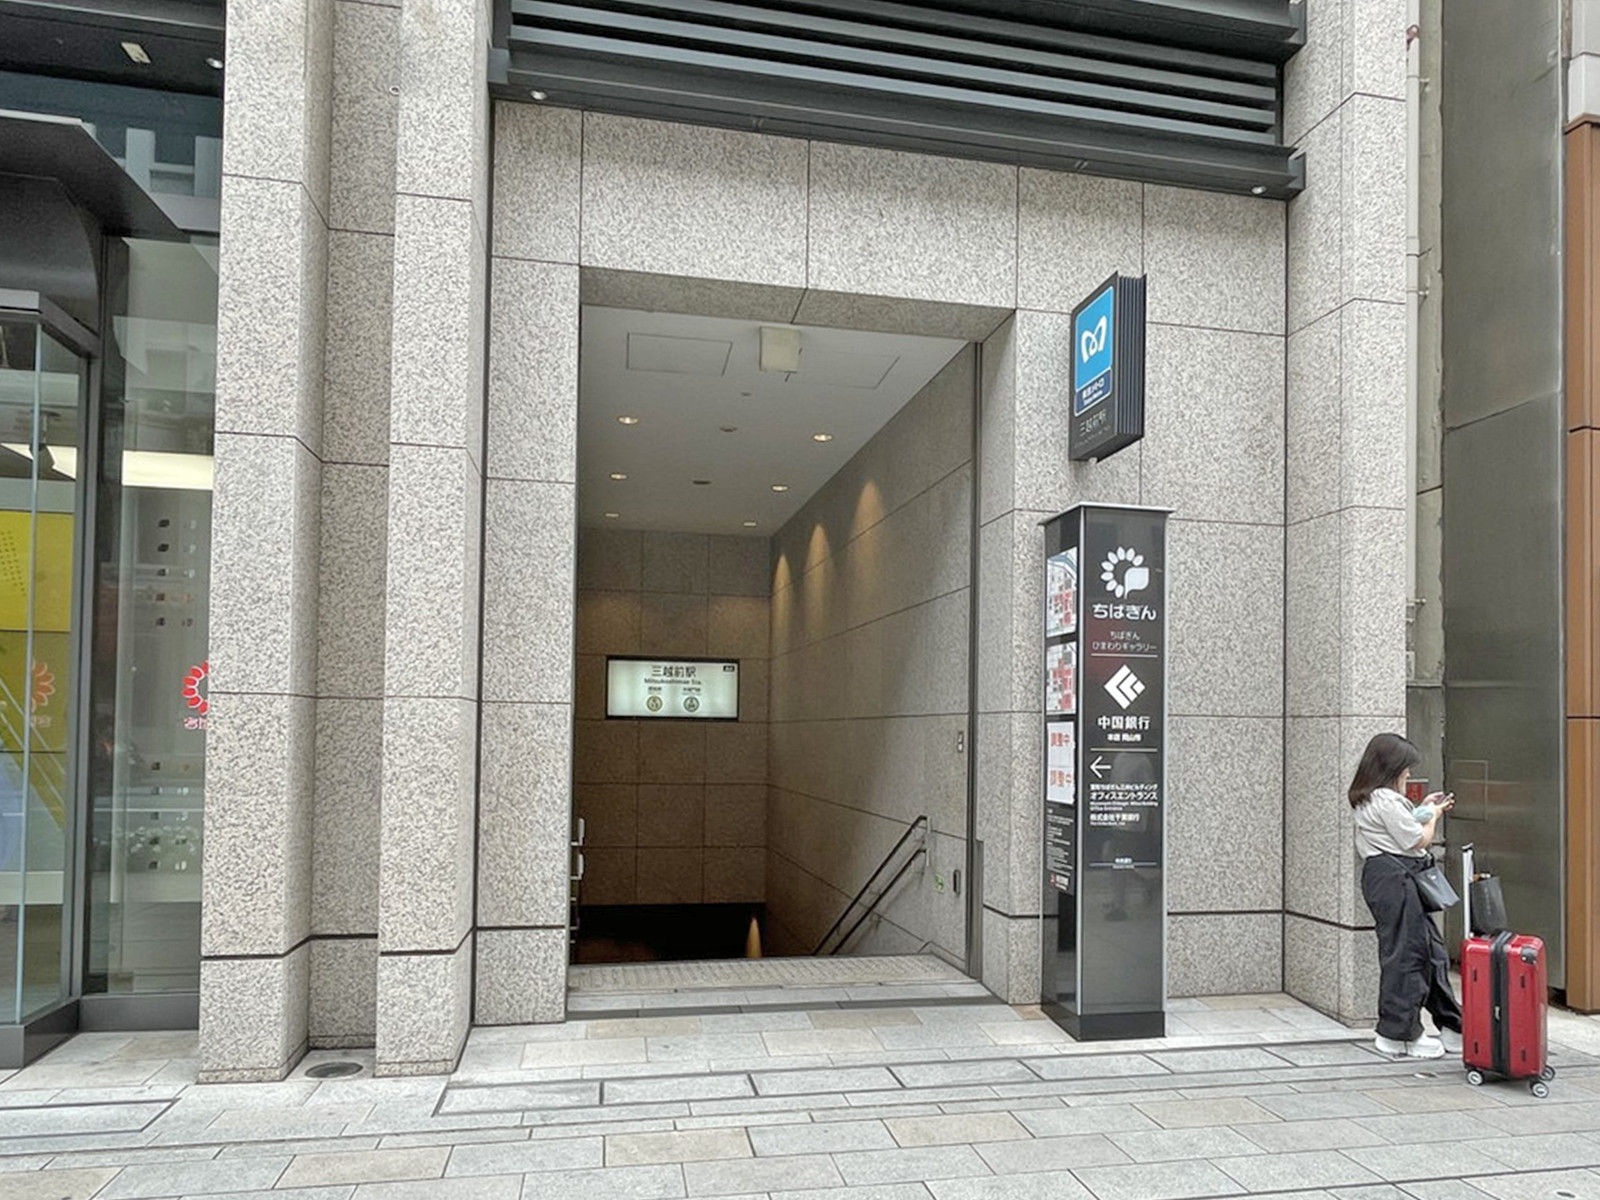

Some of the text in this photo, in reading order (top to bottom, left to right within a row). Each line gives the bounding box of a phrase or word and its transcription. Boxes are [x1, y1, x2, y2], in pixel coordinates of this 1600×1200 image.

[1092, 603, 1157, 621] ちばぎん
[1110, 630, 1141, 641] ちばぎん
[1092, 641, 1157, 652] ひまわりギャラリー
[651, 665, 697, 678] 三越前駅
[1097, 715, 1151, 730] 中国銀行
[1089, 791, 1158, 800] オフィスエントランス
